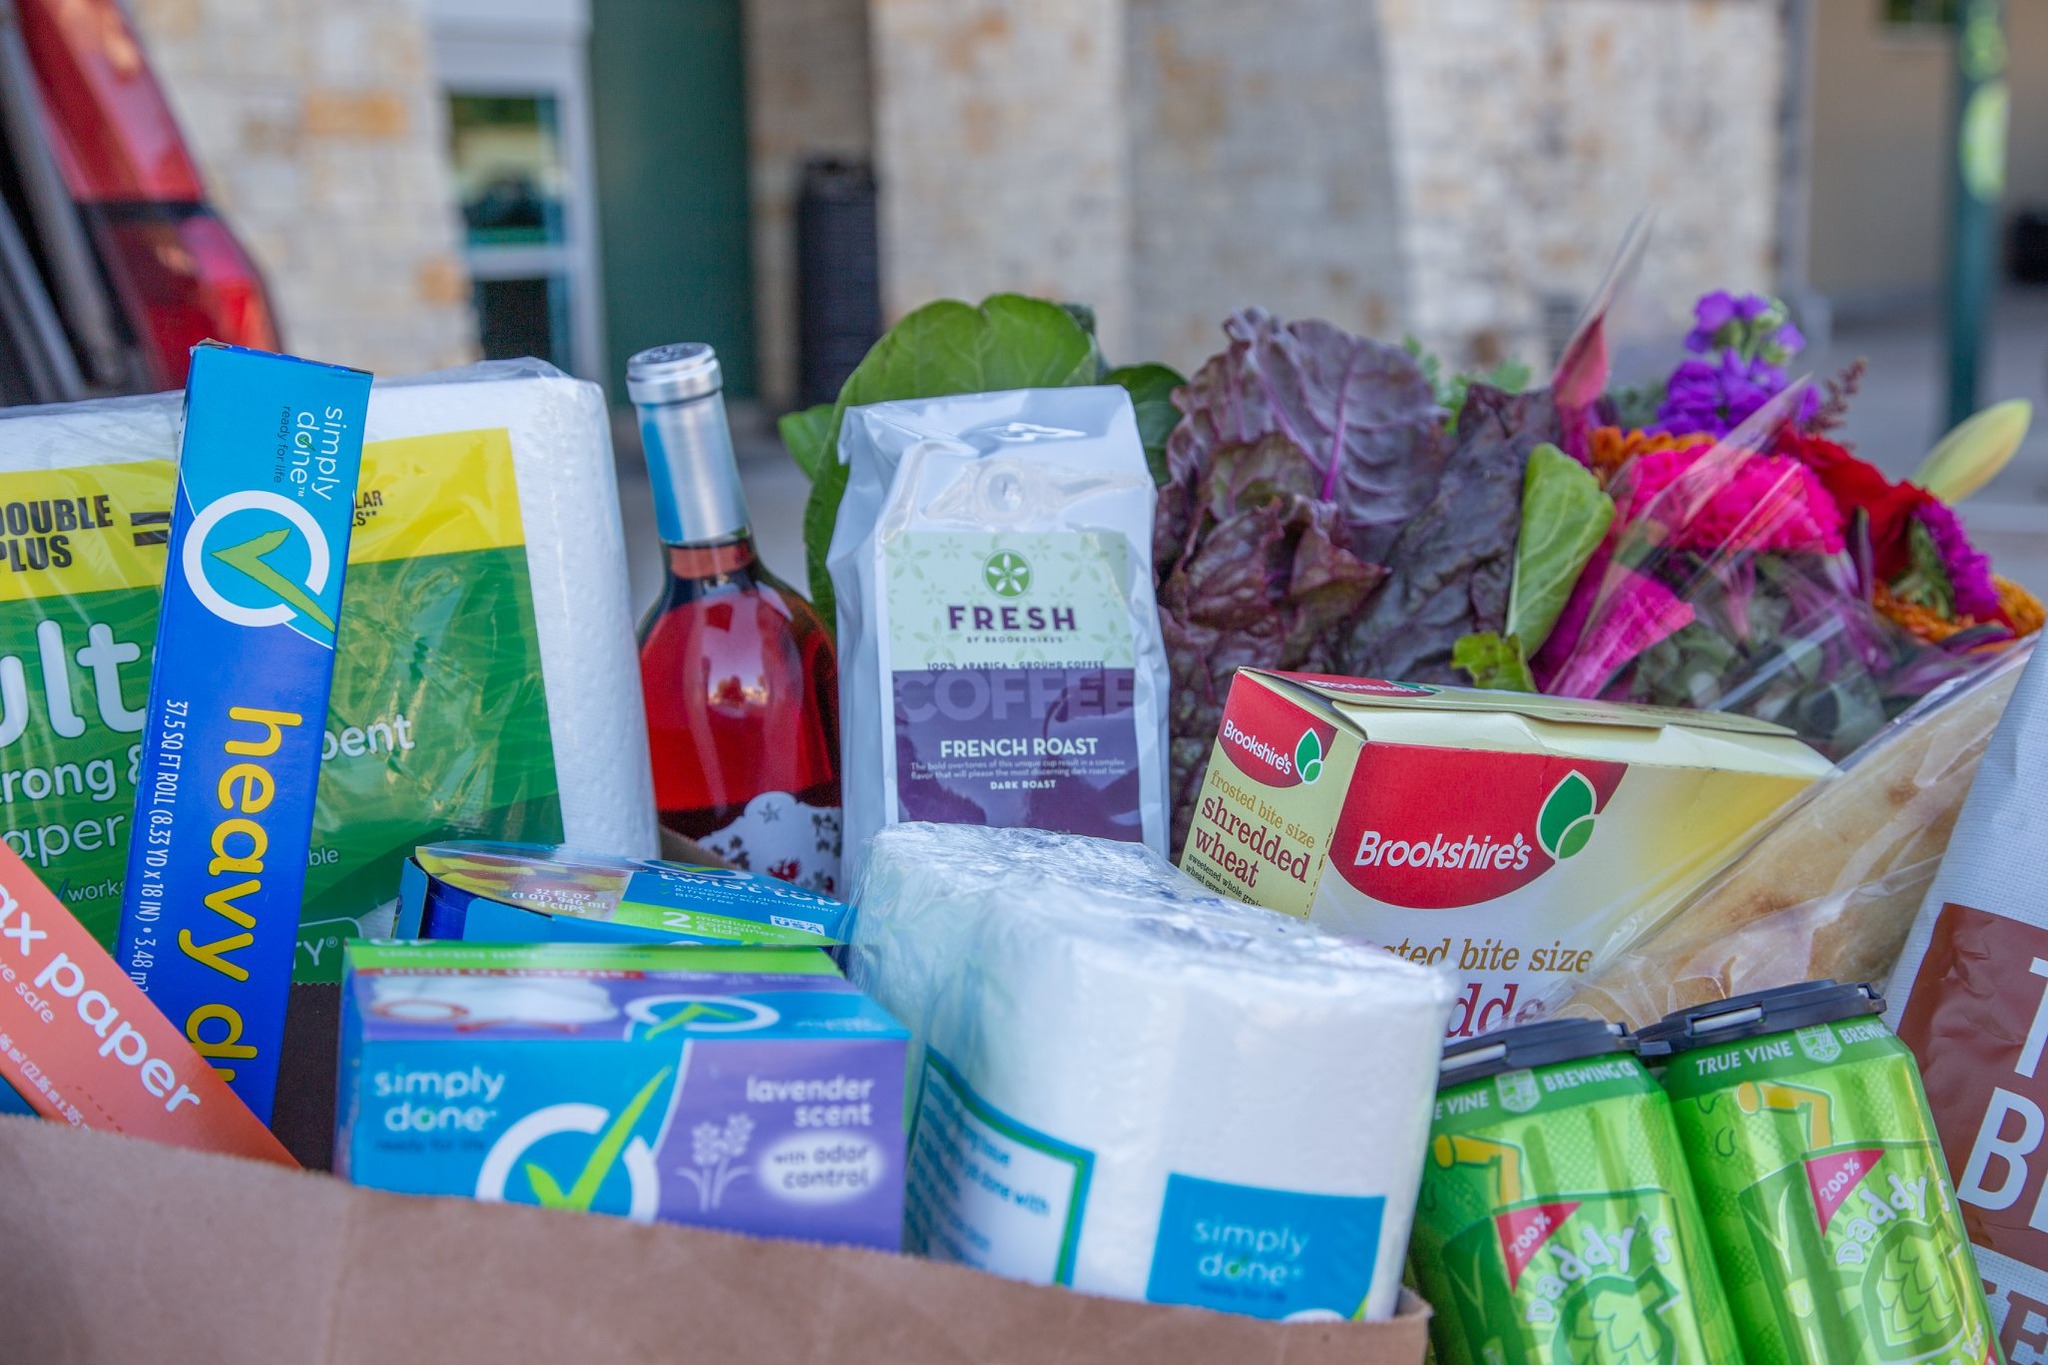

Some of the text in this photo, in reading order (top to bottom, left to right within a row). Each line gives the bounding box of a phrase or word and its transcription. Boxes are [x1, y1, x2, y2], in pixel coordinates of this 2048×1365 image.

[273, 405, 291, 483] ready for life
[311, 405, 348, 501] simply
[0, 495, 113, 537] OUBLE
[948, 605, 1077, 631] FRESH
[967, 636, 979, 644] BY
[1019, 660, 1063, 670] GROUND
[1066, 659, 1106, 670] COFFEE
[894, 668, 1135, 722] COFFEE
[163, 698, 188, 729] 37.5
[160, 731, 184, 750] SQ
[940, 737, 1098, 759] FRENCH ROAST
[1222, 719, 1293, 776] Brookshire's
[158, 753, 182, 770] FT
[0, 759, 117, 803] rong
[153, 771, 179, 805] ROLL
[989, 779, 1057, 790] DARK ROAST
[1209, 769, 1315, 849] frosted bite size
[148, 809, 173, 845] (8.33
[177, 705, 303, 983] heavy
[1201, 795, 1311, 884] shredded
[145, 848, 169, 867] YD
[1194, 826, 1260, 889] wheat
[1354, 830, 1533, 871] Brookshire's
[141, 883, 164, 897] 18
[1185, 864, 1205, 884] wheat
[1187, 853, 1222, 881] sweetened
[1222, 878, 1243, 897] whole
[134, 901, 162, 922] IN)
[534, 887, 592, 901] 32 FL OZ
[536, 901, 586, 914] 4 CUPS
[662, 911, 692, 930] 2
[695, 914, 762, 931] medium
[131, 937, 156, 968] 3.48
[1458, 938, 1520, 972] bite
[1528, 940, 1594, 974] size
[15, 981, 54, 1024] safe
[33, 951, 201, 1113] paper
[1696, 1051, 1742, 1076] TRUE
[1744, 1040, 1794, 1065] VINE
[373, 1064, 506, 1103] simply
[745, 1074, 876, 1104] lavender
[1447, 1089, 1490, 1116] VINE
[1542, 1061, 1622, 1093] BREWING
[793, 1101, 874, 1128] scent
[773, 1144, 868, 1164] with odor
[782, 1168, 870, 1190] control
[1819, 1157, 1861, 1203] 200%
[1193, 1218, 1310, 1258] simply
[1508, 1212, 1552, 1259] 200%
